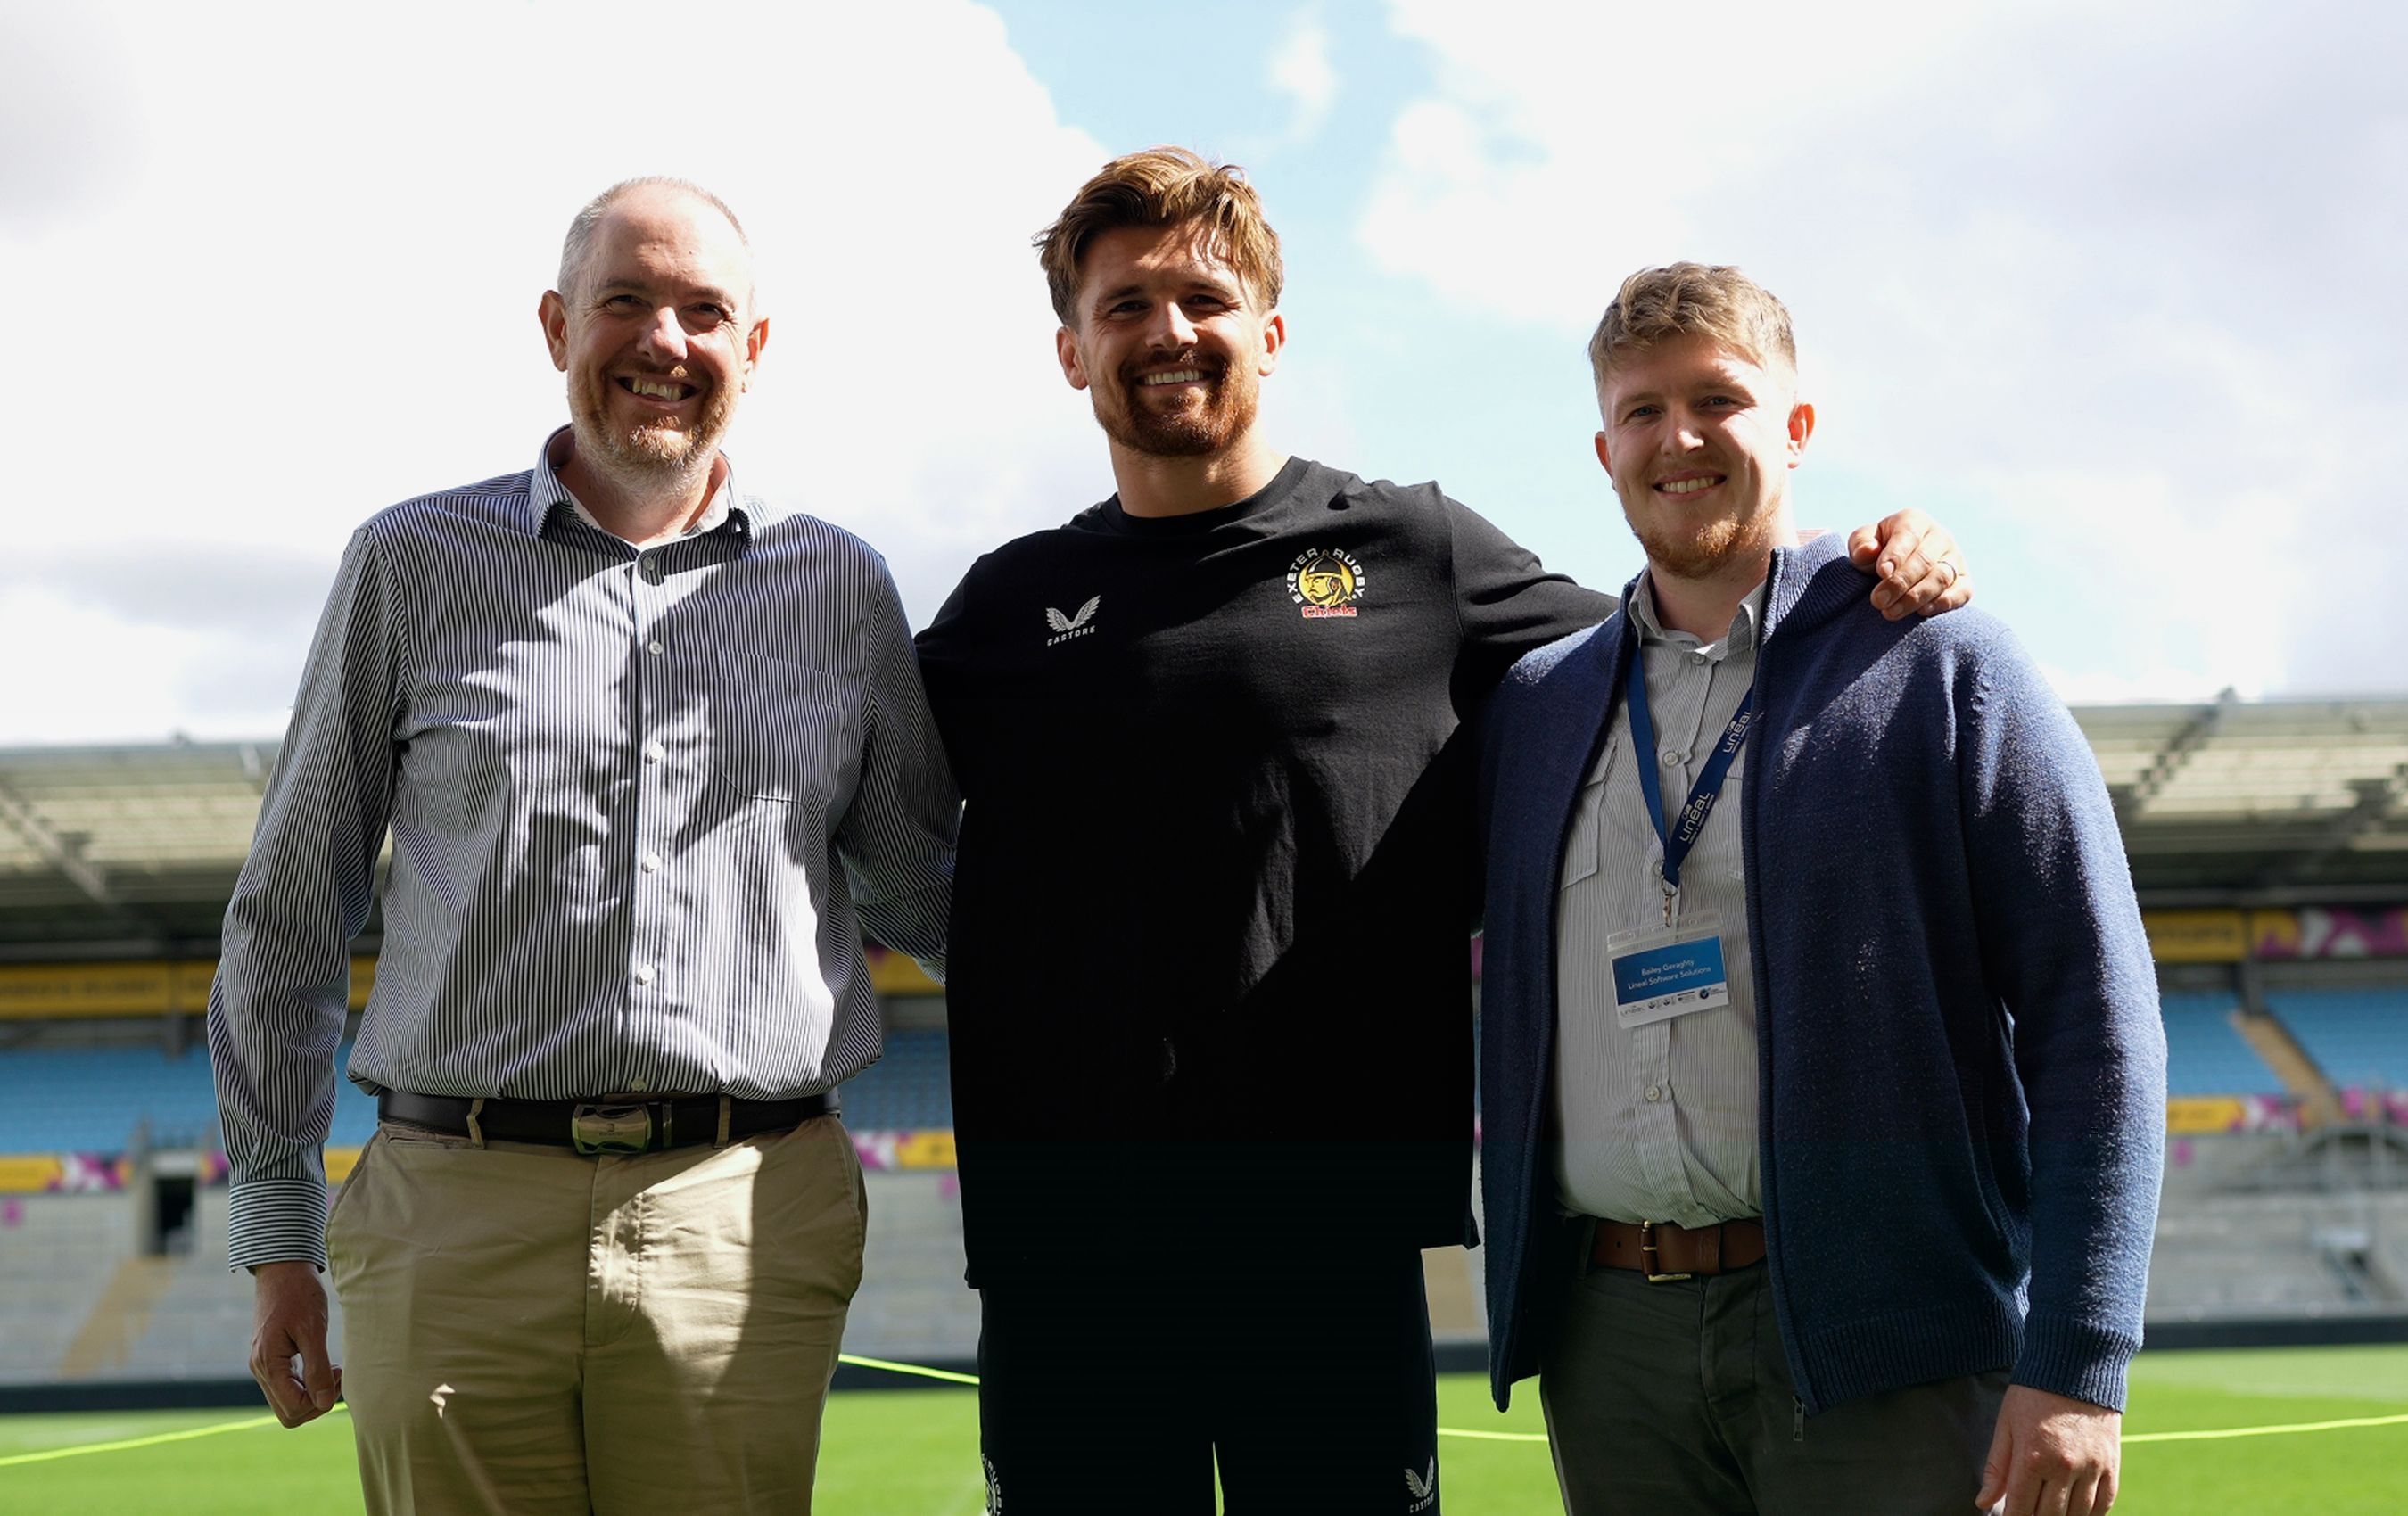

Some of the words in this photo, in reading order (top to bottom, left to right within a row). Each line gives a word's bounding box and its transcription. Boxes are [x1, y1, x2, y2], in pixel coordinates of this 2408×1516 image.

[1286, 548, 1318, 604] EXETER
[1332, 548, 1365, 598] RUGBY
[1301, 604, 1358, 619] Chiefs
[1046, 624, 1096, 647] CASTORE
[1628, 979, 1649, 990] Lineal
[1648, 972, 1678, 985] Software
[1679, 966, 1712, 978] Solutions
[1641, 966, 1662, 976] Bailey
[1662, 959, 1695, 972] Geraghty
